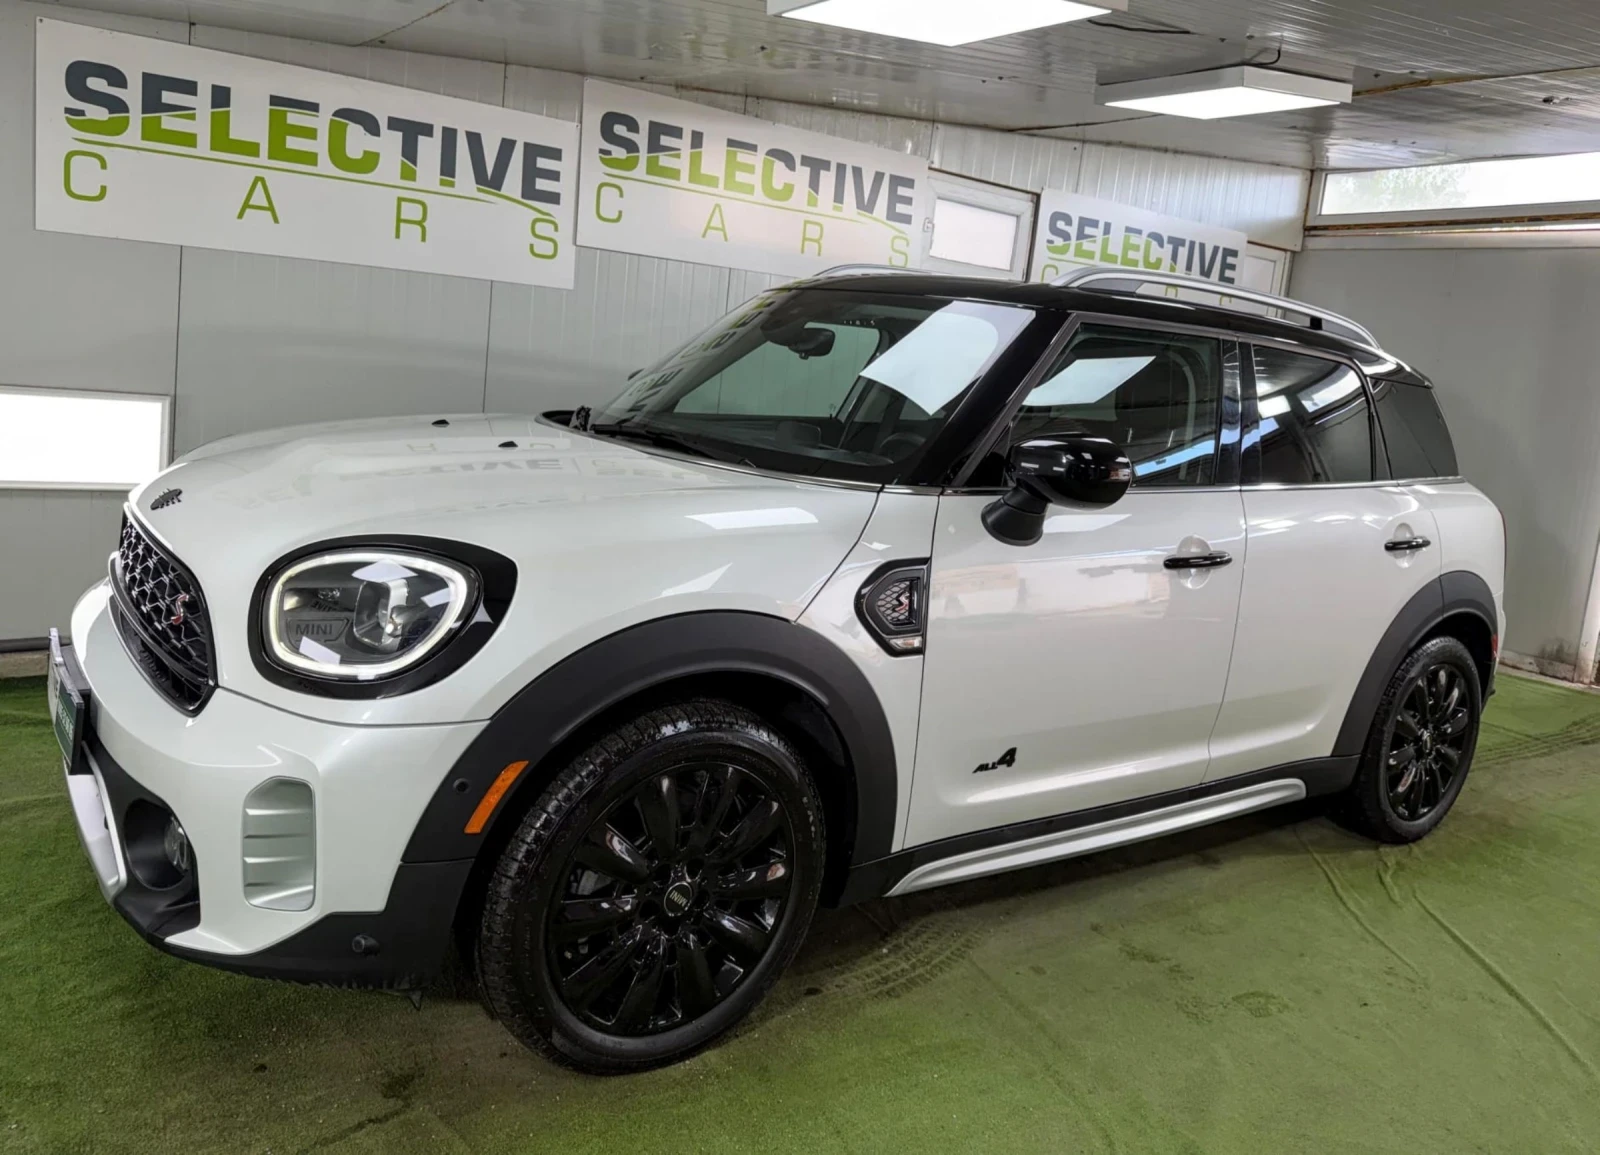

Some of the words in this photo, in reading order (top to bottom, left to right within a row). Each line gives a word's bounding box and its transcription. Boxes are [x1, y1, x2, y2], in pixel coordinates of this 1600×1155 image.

[63, 60, 563, 205] SELECTIVE
[598, 111, 916, 225] SELECTIVE
[1046, 211, 1239, 285] SELECTIVE
[295, 623, 333, 635] MINI
